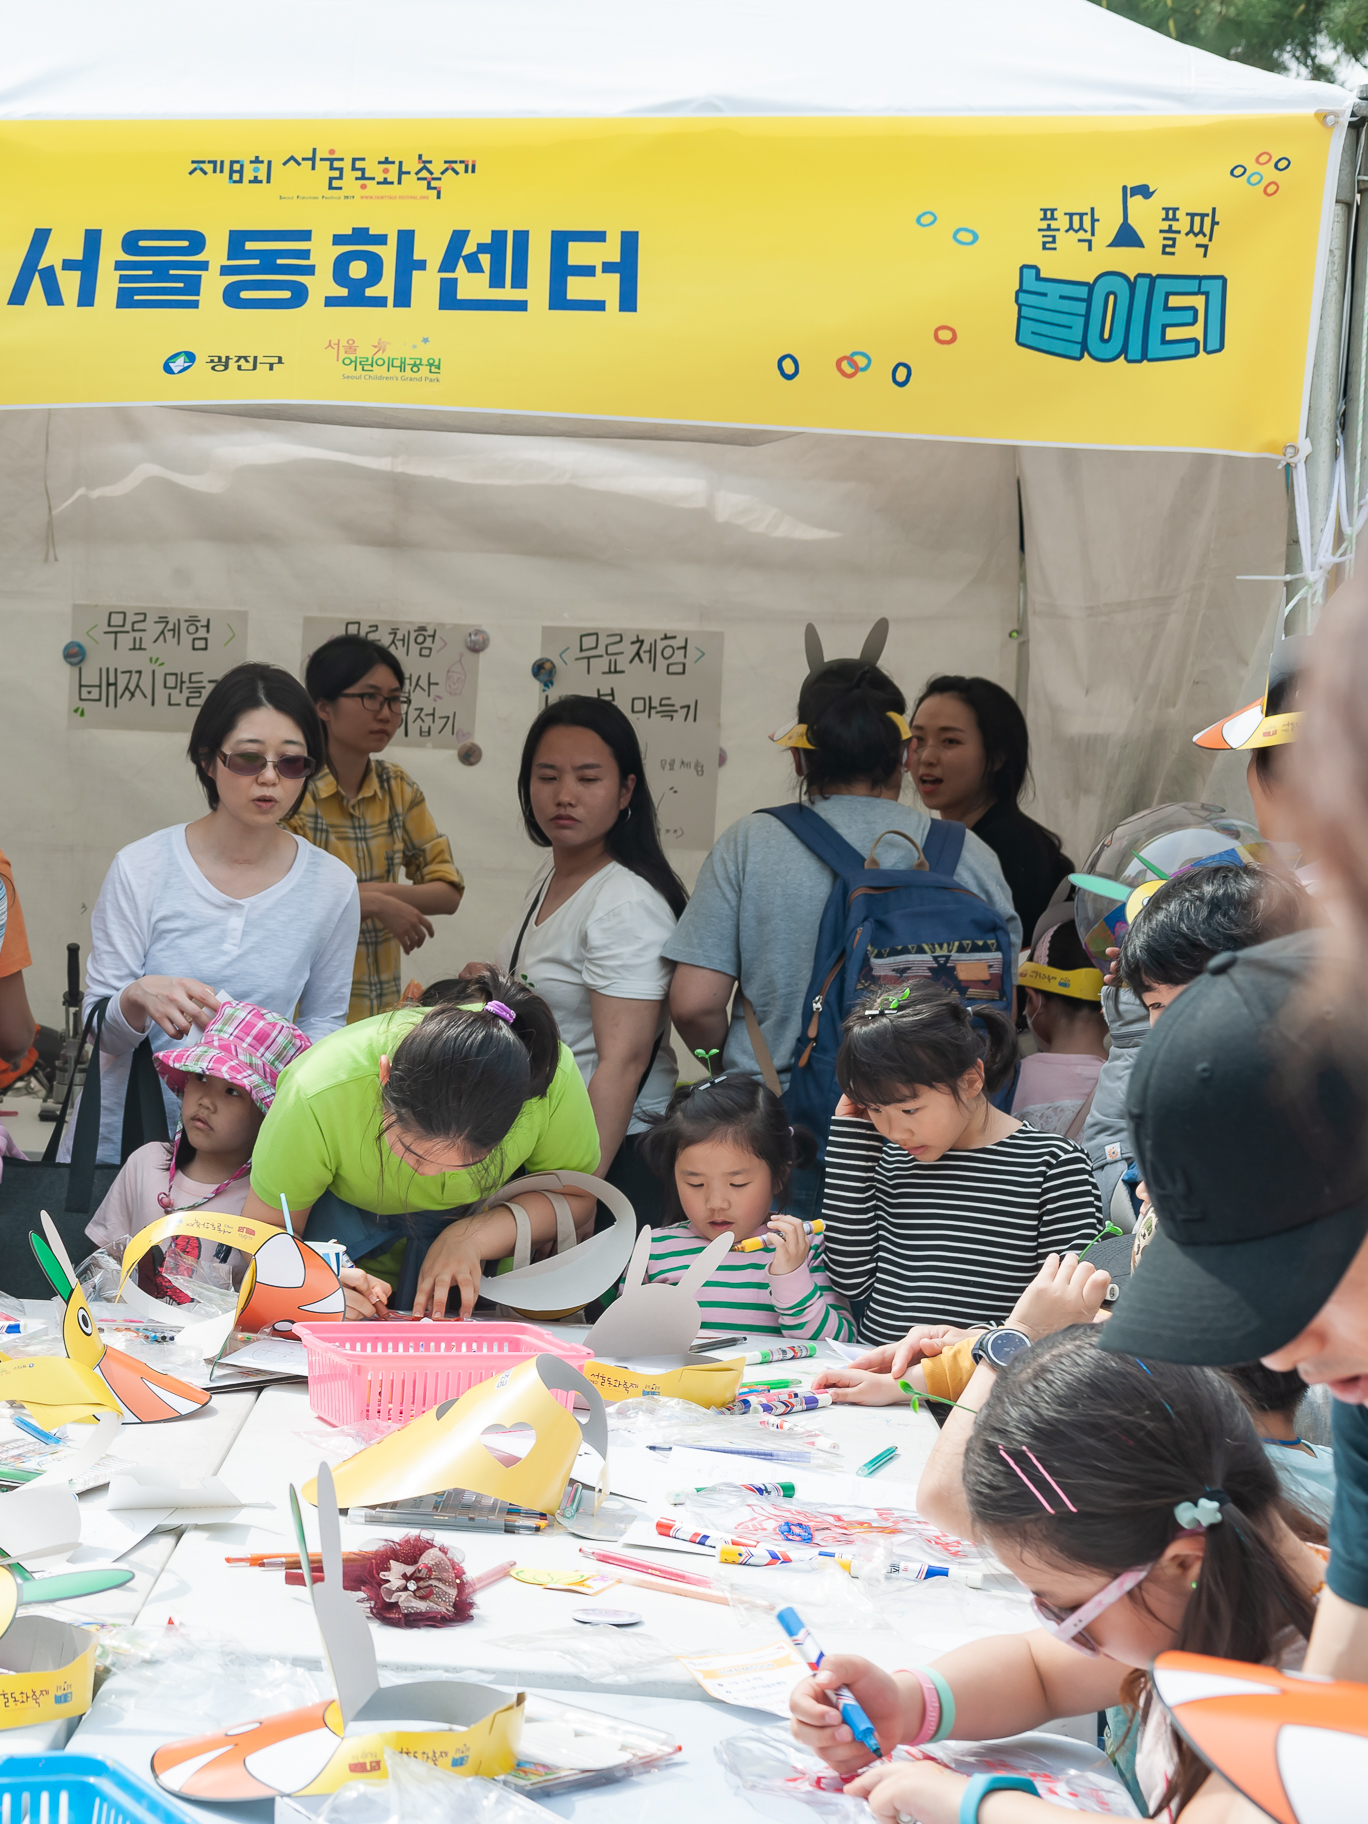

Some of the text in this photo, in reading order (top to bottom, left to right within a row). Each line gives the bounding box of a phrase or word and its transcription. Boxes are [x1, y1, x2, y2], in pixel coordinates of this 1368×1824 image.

[187, 155, 273, 185] 제8회
[1037, 206, 1221, 258] 폴짝 폴짝
[6, 226, 640, 313] 서울동화센터
[1014, 263, 1228, 364] 놀이터
[205, 354, 285, 373] 광진구
[323, 338, 360, 363] 서울
[341, 356, 442, 375] 어린이대공원
[363, 374, 399, 382] Children's
[399, 375, 423, 383] Grand
[163, 671, 221, 708] 만들
